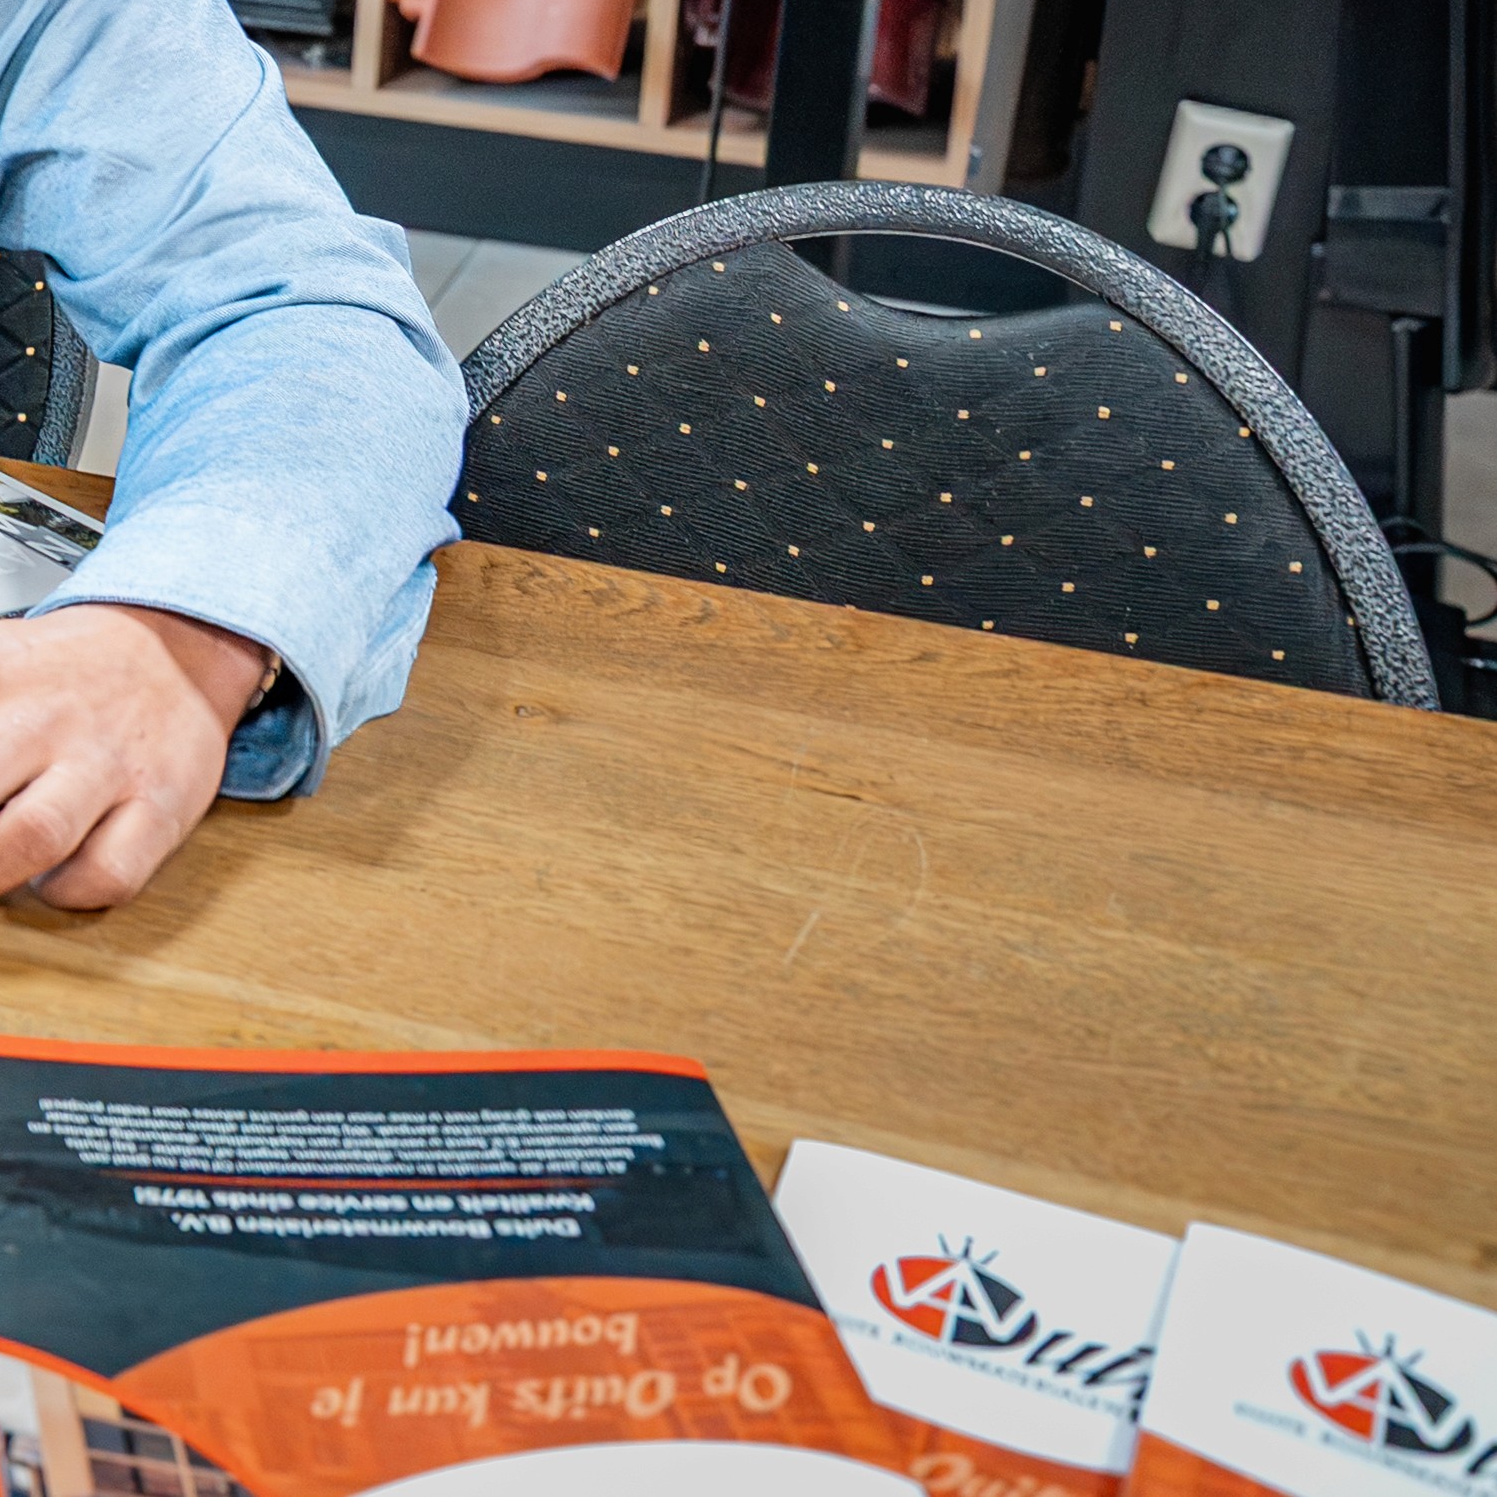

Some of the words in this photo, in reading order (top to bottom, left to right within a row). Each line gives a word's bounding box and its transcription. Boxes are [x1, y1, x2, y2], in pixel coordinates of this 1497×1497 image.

[211, 1189, 293, 1212] sinds
[297, 1193, 406, 1213] service
[412, 1194, 452, 1210] en
[456, 1192, 594, 1213] Kwaliteit
[170, 1211, 232, 1233] B.V.
[236, 1214, 491, 1237] Bouwmaterialen
[492, 1217, 580, 1238] Duits
[402, 1311, 638, 1366] bouwen!
[701, 1353, 789, 1412] Op
[309, 1377, 363, 1425] je
[387, 1380, 489, 1427] kun
